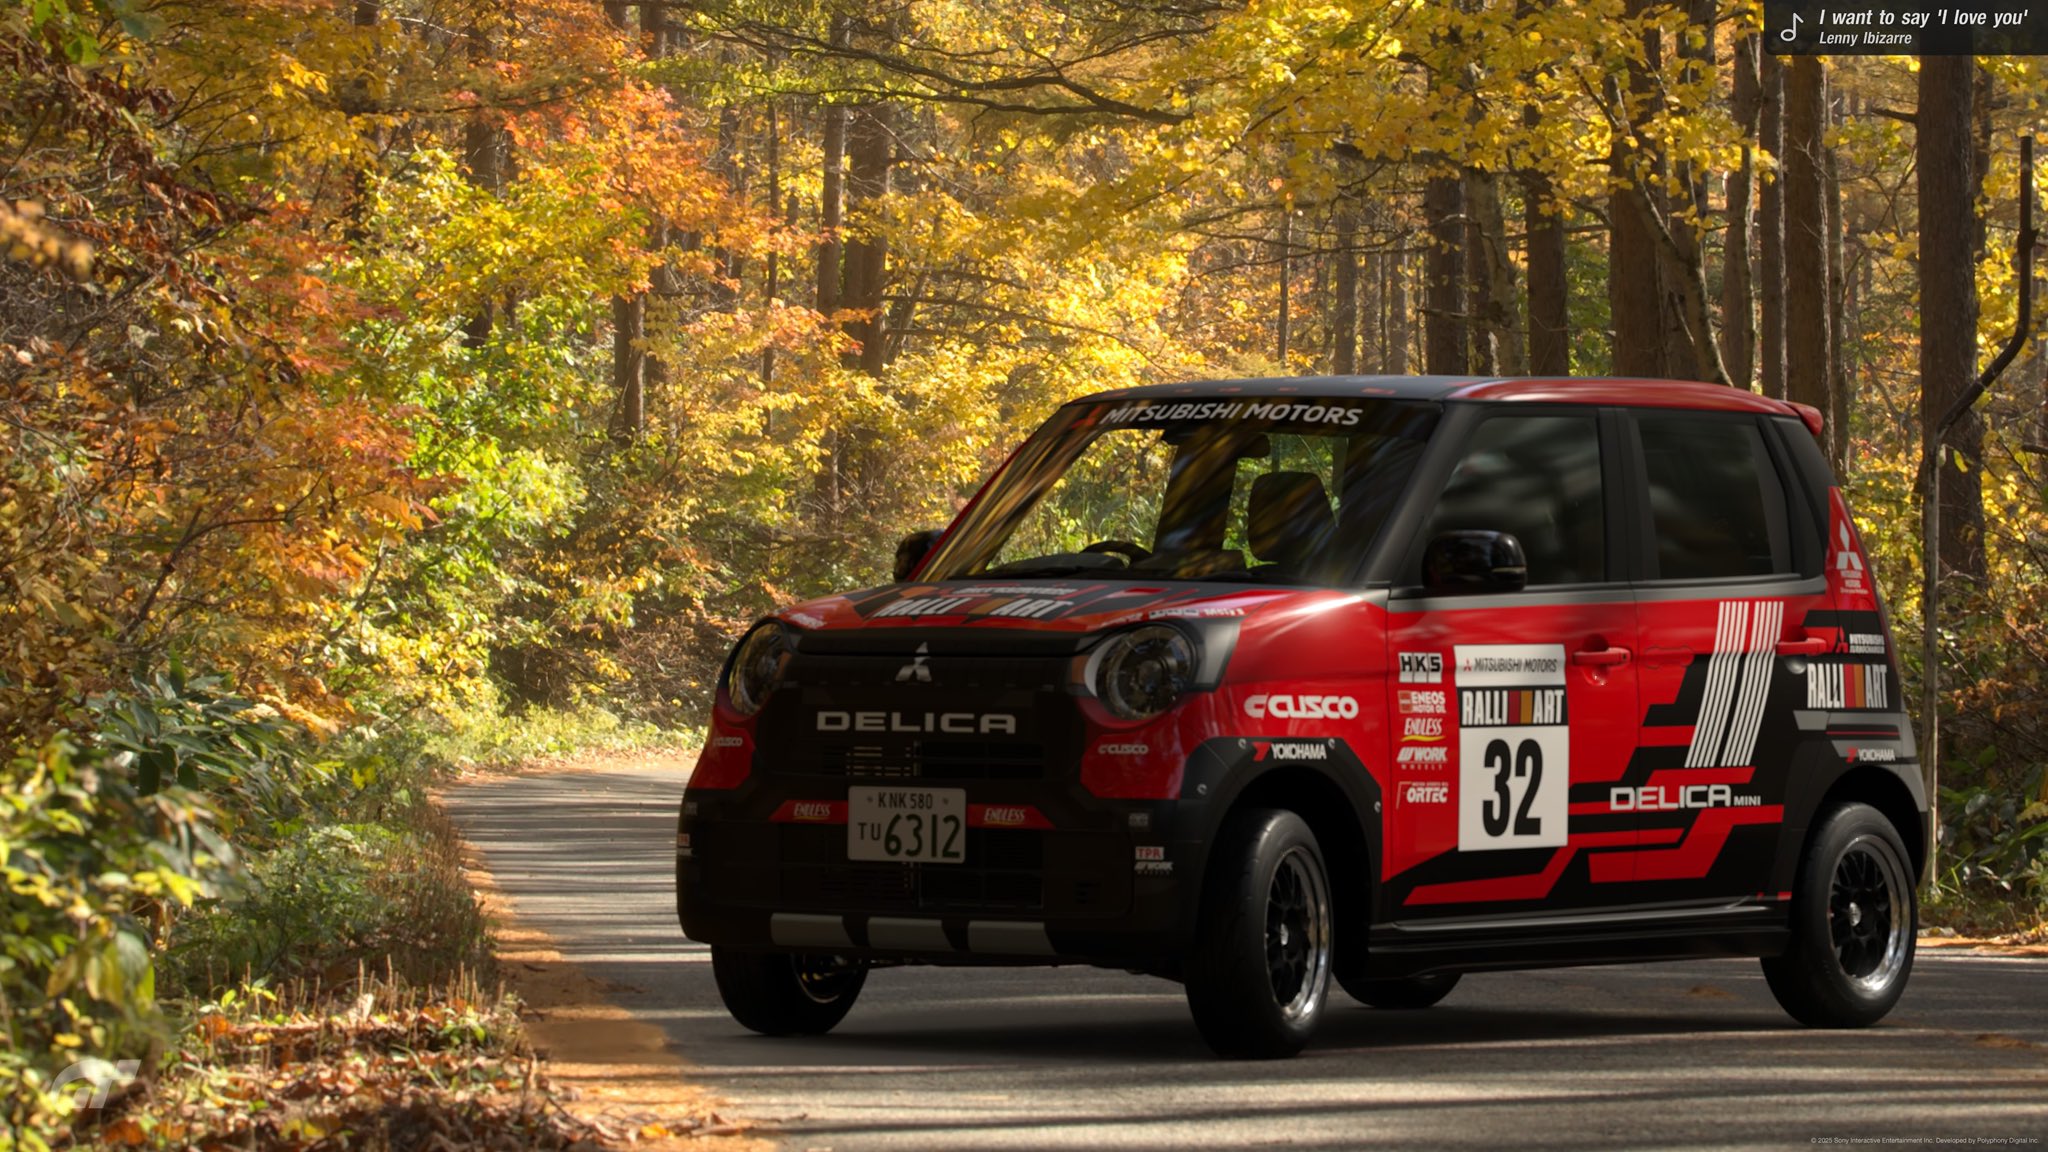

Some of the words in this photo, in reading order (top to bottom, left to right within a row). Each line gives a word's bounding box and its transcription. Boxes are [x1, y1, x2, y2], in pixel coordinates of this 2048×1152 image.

[1101, 404, 1240, 424] MITSUBISHI
[1243, 404, 1362, 425] MOTORS
[988, 599, 1075, 617] ART
[1400, 654, 1442, 673] HKS
[1474, 658, 1523, 672] MITSUBISHI
[1524, 658, 1557, 672] MOTORS
[1807, 664, 1845, 708] RALLI
[1865, 664, 1888, 708] ART
[1411, 691, 1446, 704] ENEOS
[1461, 691, 1508, 725] RALLI
[1532, 690, 1565, 724] ART
[816, 711, 1017, 734] DELICA
[1404, 718, 1443, 735] ENDLESS
[1271, 743, 1327, 760] YOKOHAMA
[1413, 747, 1448, 761] WORK
[1482, 738, 1543, 837] 32
[877, 791, 908, 809] KNK
[909, 792, 933, 809] 580
[1610, 784, 1732, 811] DELICA
[1733, 796, 1761, 807] MINI
[793, 803, 831, 817] ENDLESS
[984, 808, 1025, 822] ENDLESS
[858, 822, 881, 841] TU
[884, 813, 961, 859] 6312
[1136, 847, 1163, 859] TPR
